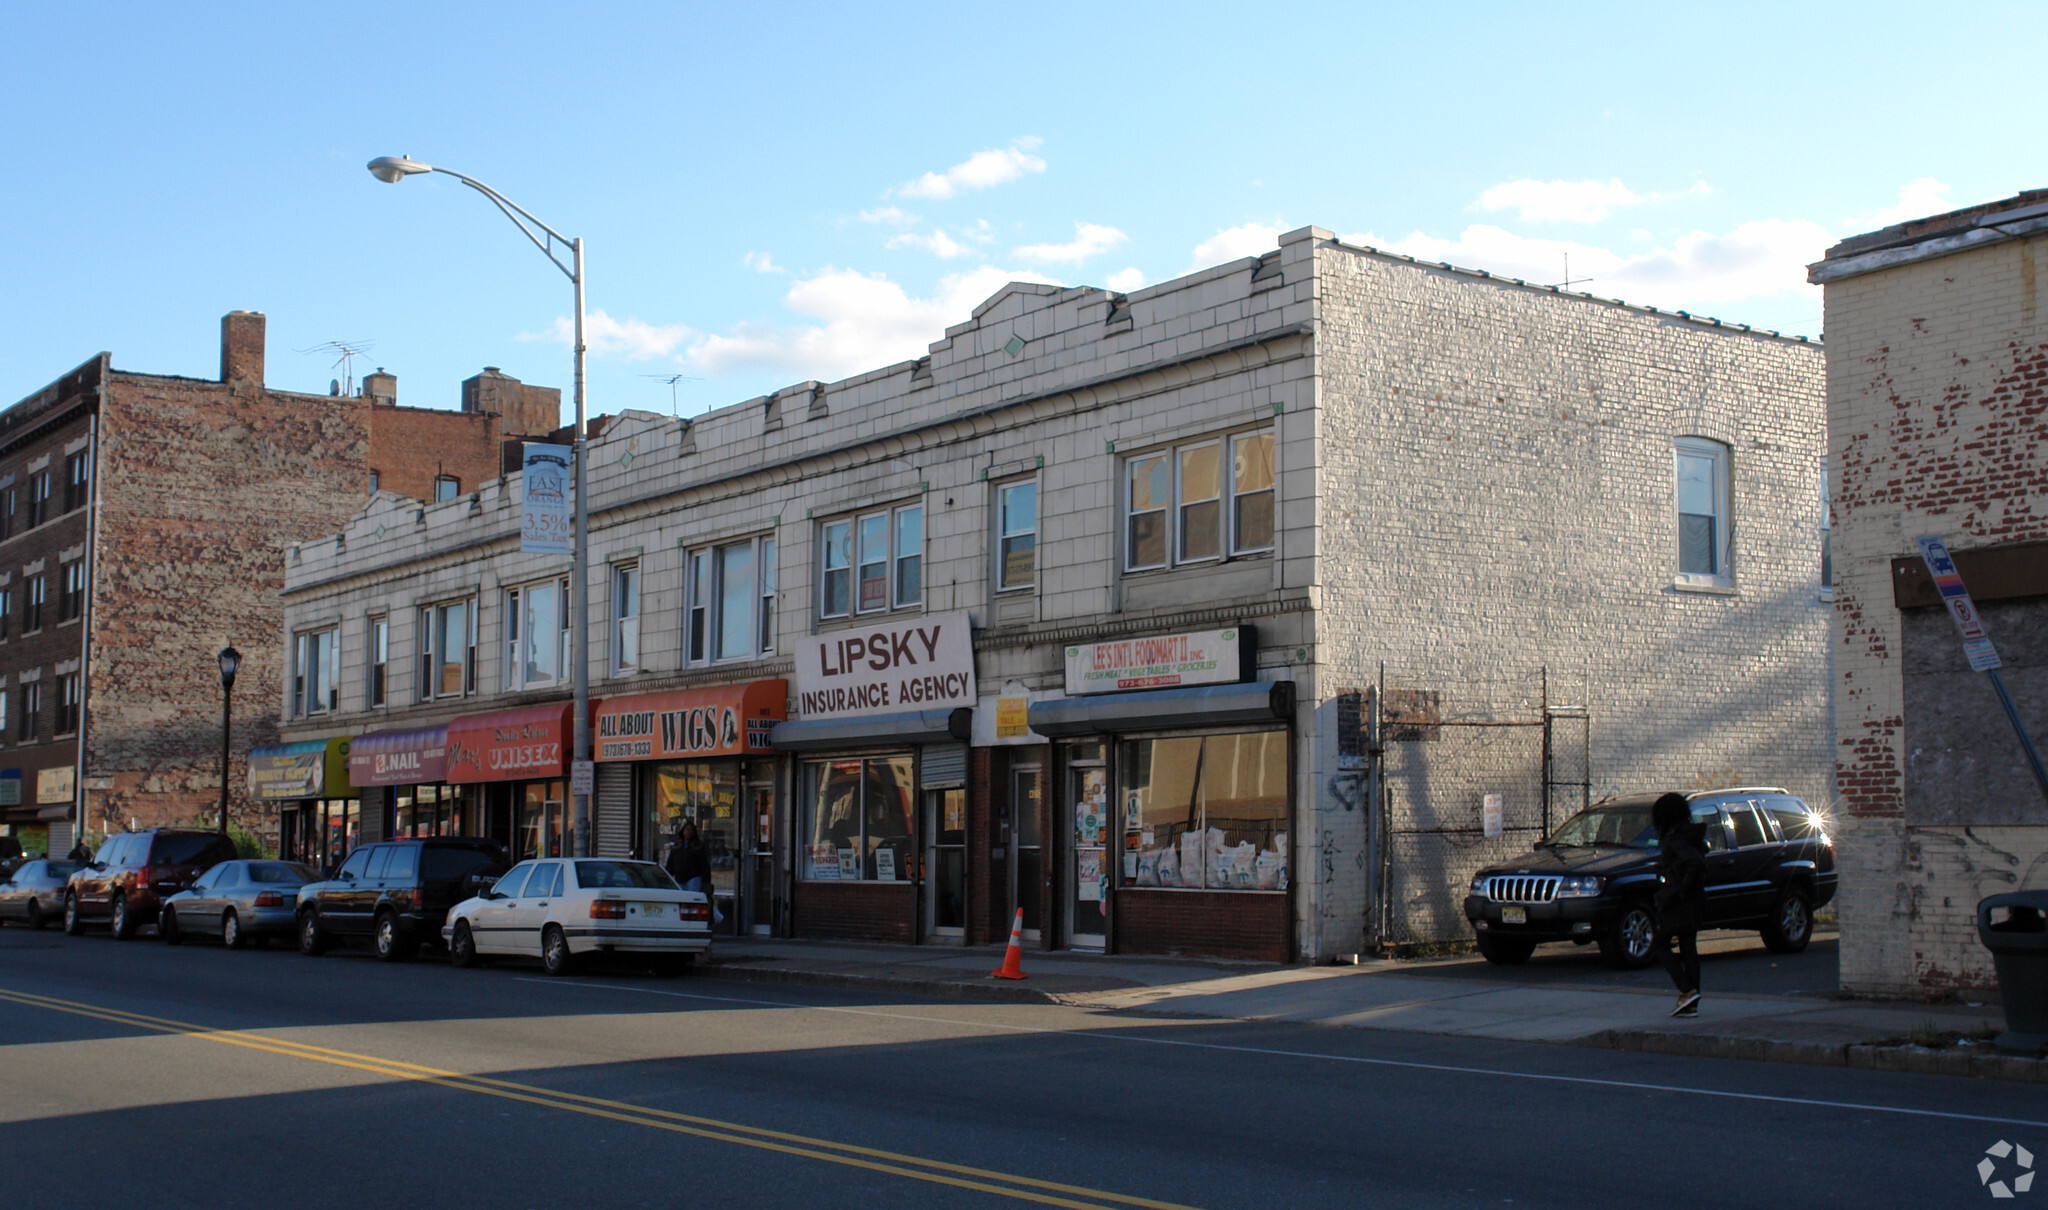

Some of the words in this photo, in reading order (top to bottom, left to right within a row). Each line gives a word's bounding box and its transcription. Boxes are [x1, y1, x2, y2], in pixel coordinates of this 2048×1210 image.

[528, 474, 565, 495] EAST
[523, 512, 568, 532] 3.5%
[522, 530, 548, 542] Sales
[550, 531, 568, 543] Tax
[820, 625, 941, 676] LIPSKY
[1093, 643, 1112, 670] LEE'S
[1113, 641, 1133, 668] INT'L
[1135, 636, 1178, 667] FOODMART
[1083, 669, 1105, 681] FRESH
[1104, 668, 1122, 680] MEAT
[1129, 664, 1171, 678] VEGETABLES
[1177, 660, 1218, 673] GROCERIES
[801, 682, 889, 715] INSURANCE
[899, 672, 969, 704] AGENCY
[600, 715, 616, 736] ALL
[619, 712, 654, 735] ABOUT
[660, 707, 717, 752] WIGS
[487, 742, 559, 770] UNISEX
